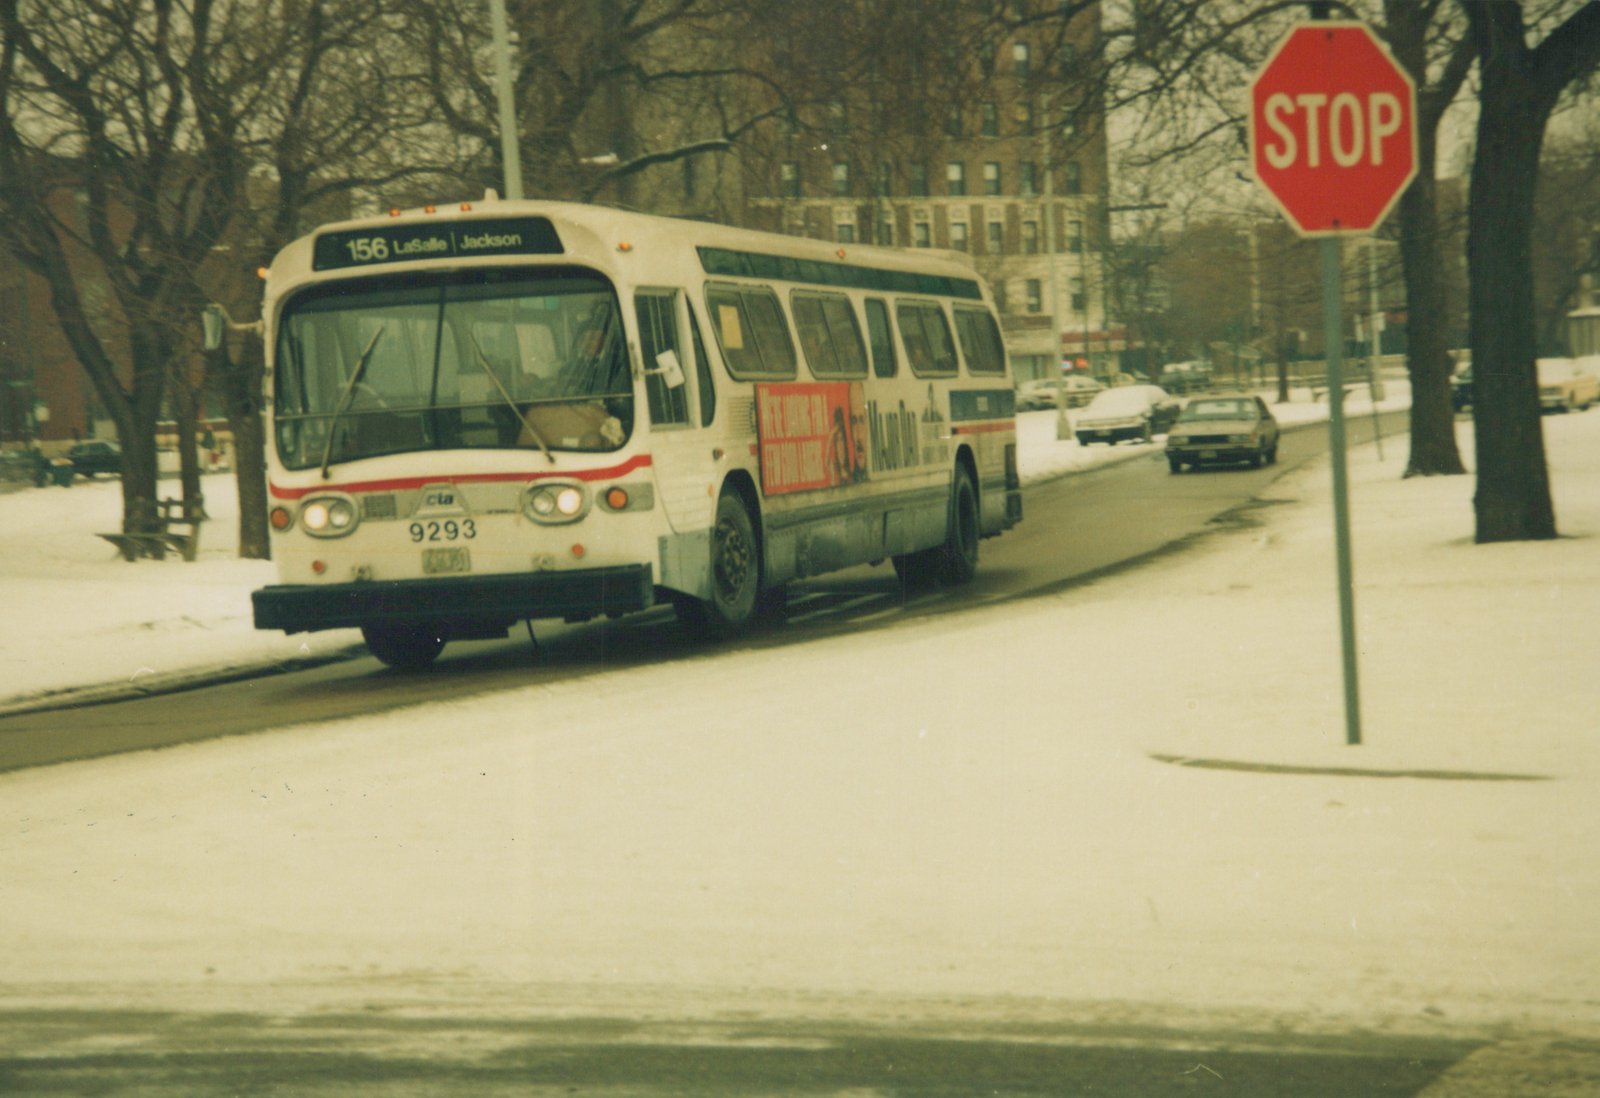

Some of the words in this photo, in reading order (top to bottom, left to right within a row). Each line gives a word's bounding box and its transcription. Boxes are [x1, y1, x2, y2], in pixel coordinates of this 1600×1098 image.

[1264, 92, 1402, 169] STOP
[346, 237, 389, 261] 156
[393, 237, 447, 255] LaSalle
[460, 233, 521, 249] Jackson
[409, 519, 477, 542] 9293
